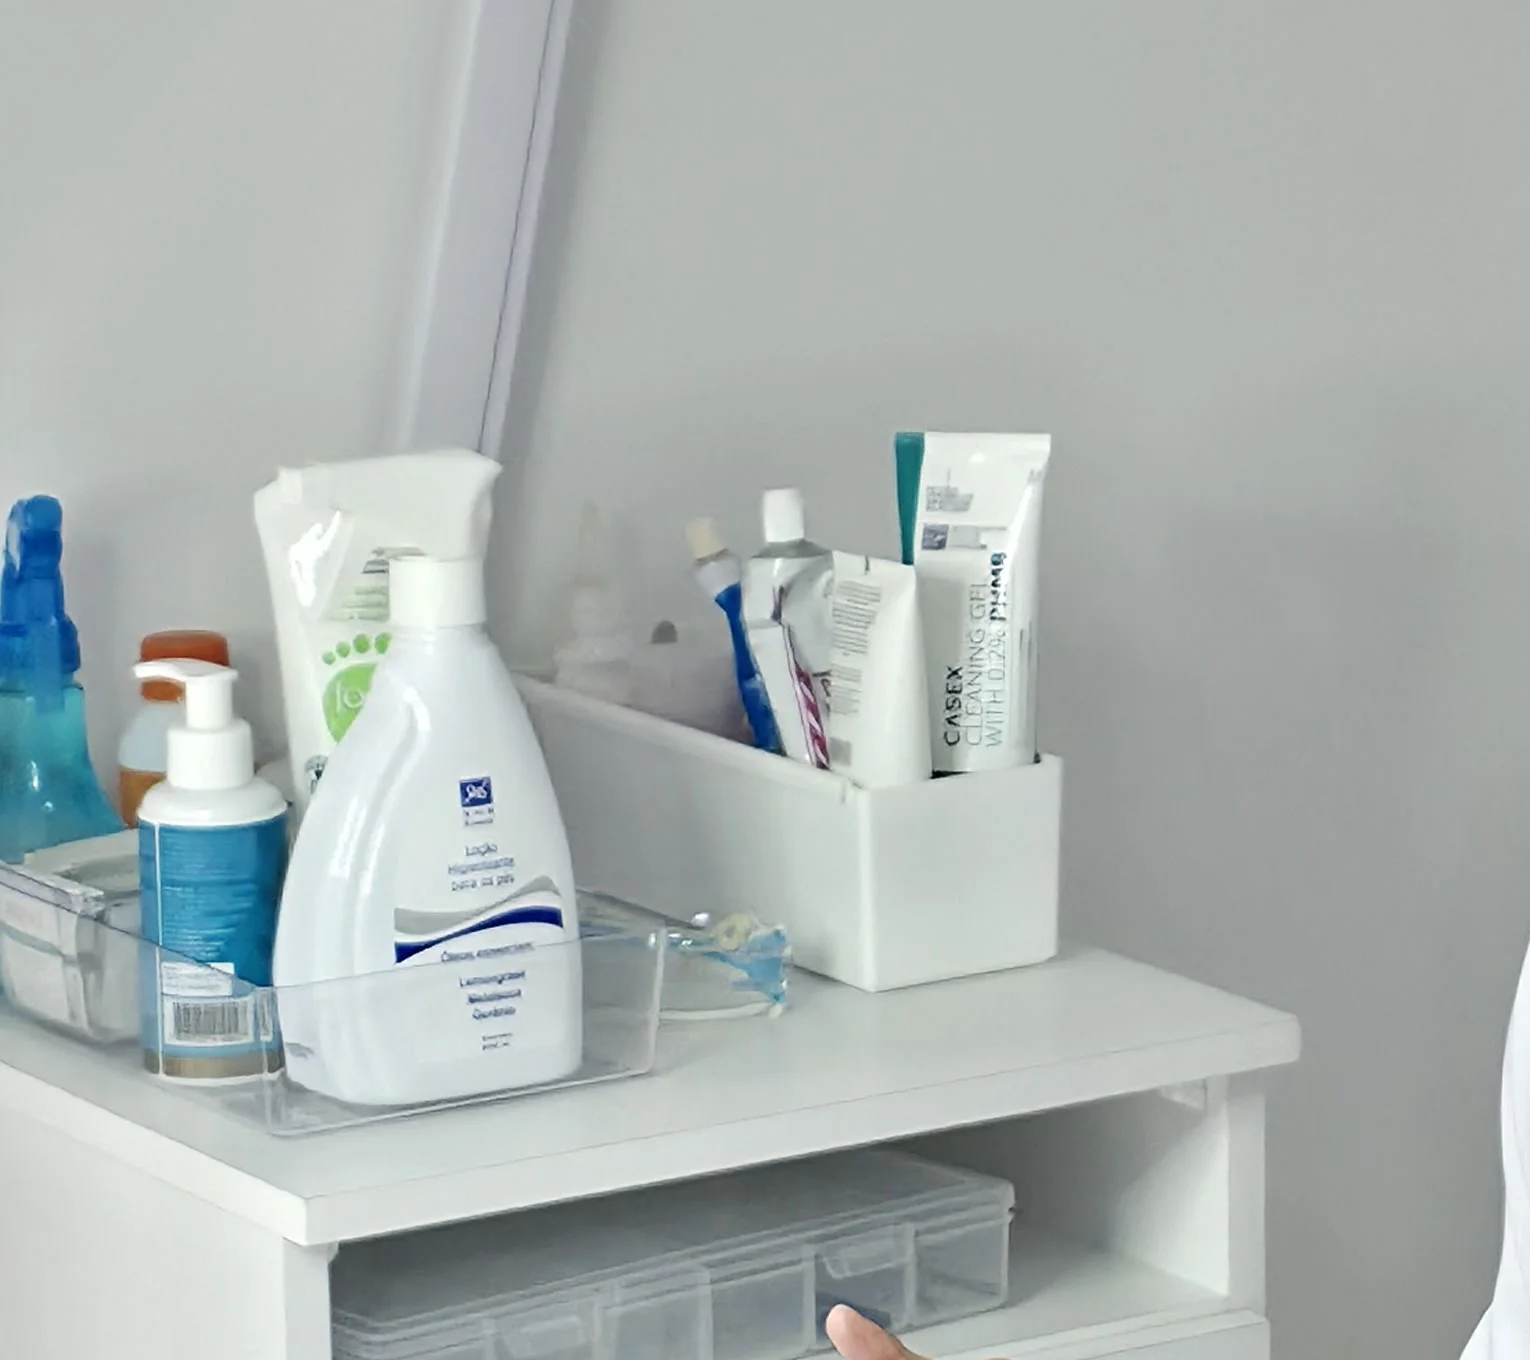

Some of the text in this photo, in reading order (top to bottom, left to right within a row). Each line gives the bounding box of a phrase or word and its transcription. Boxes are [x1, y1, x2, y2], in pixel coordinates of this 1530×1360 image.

[965, 582, 988, 747] CLEANING GEL
[943, 665, 963, 747] CASEX
[985, 687, 1004, 748] WITH
